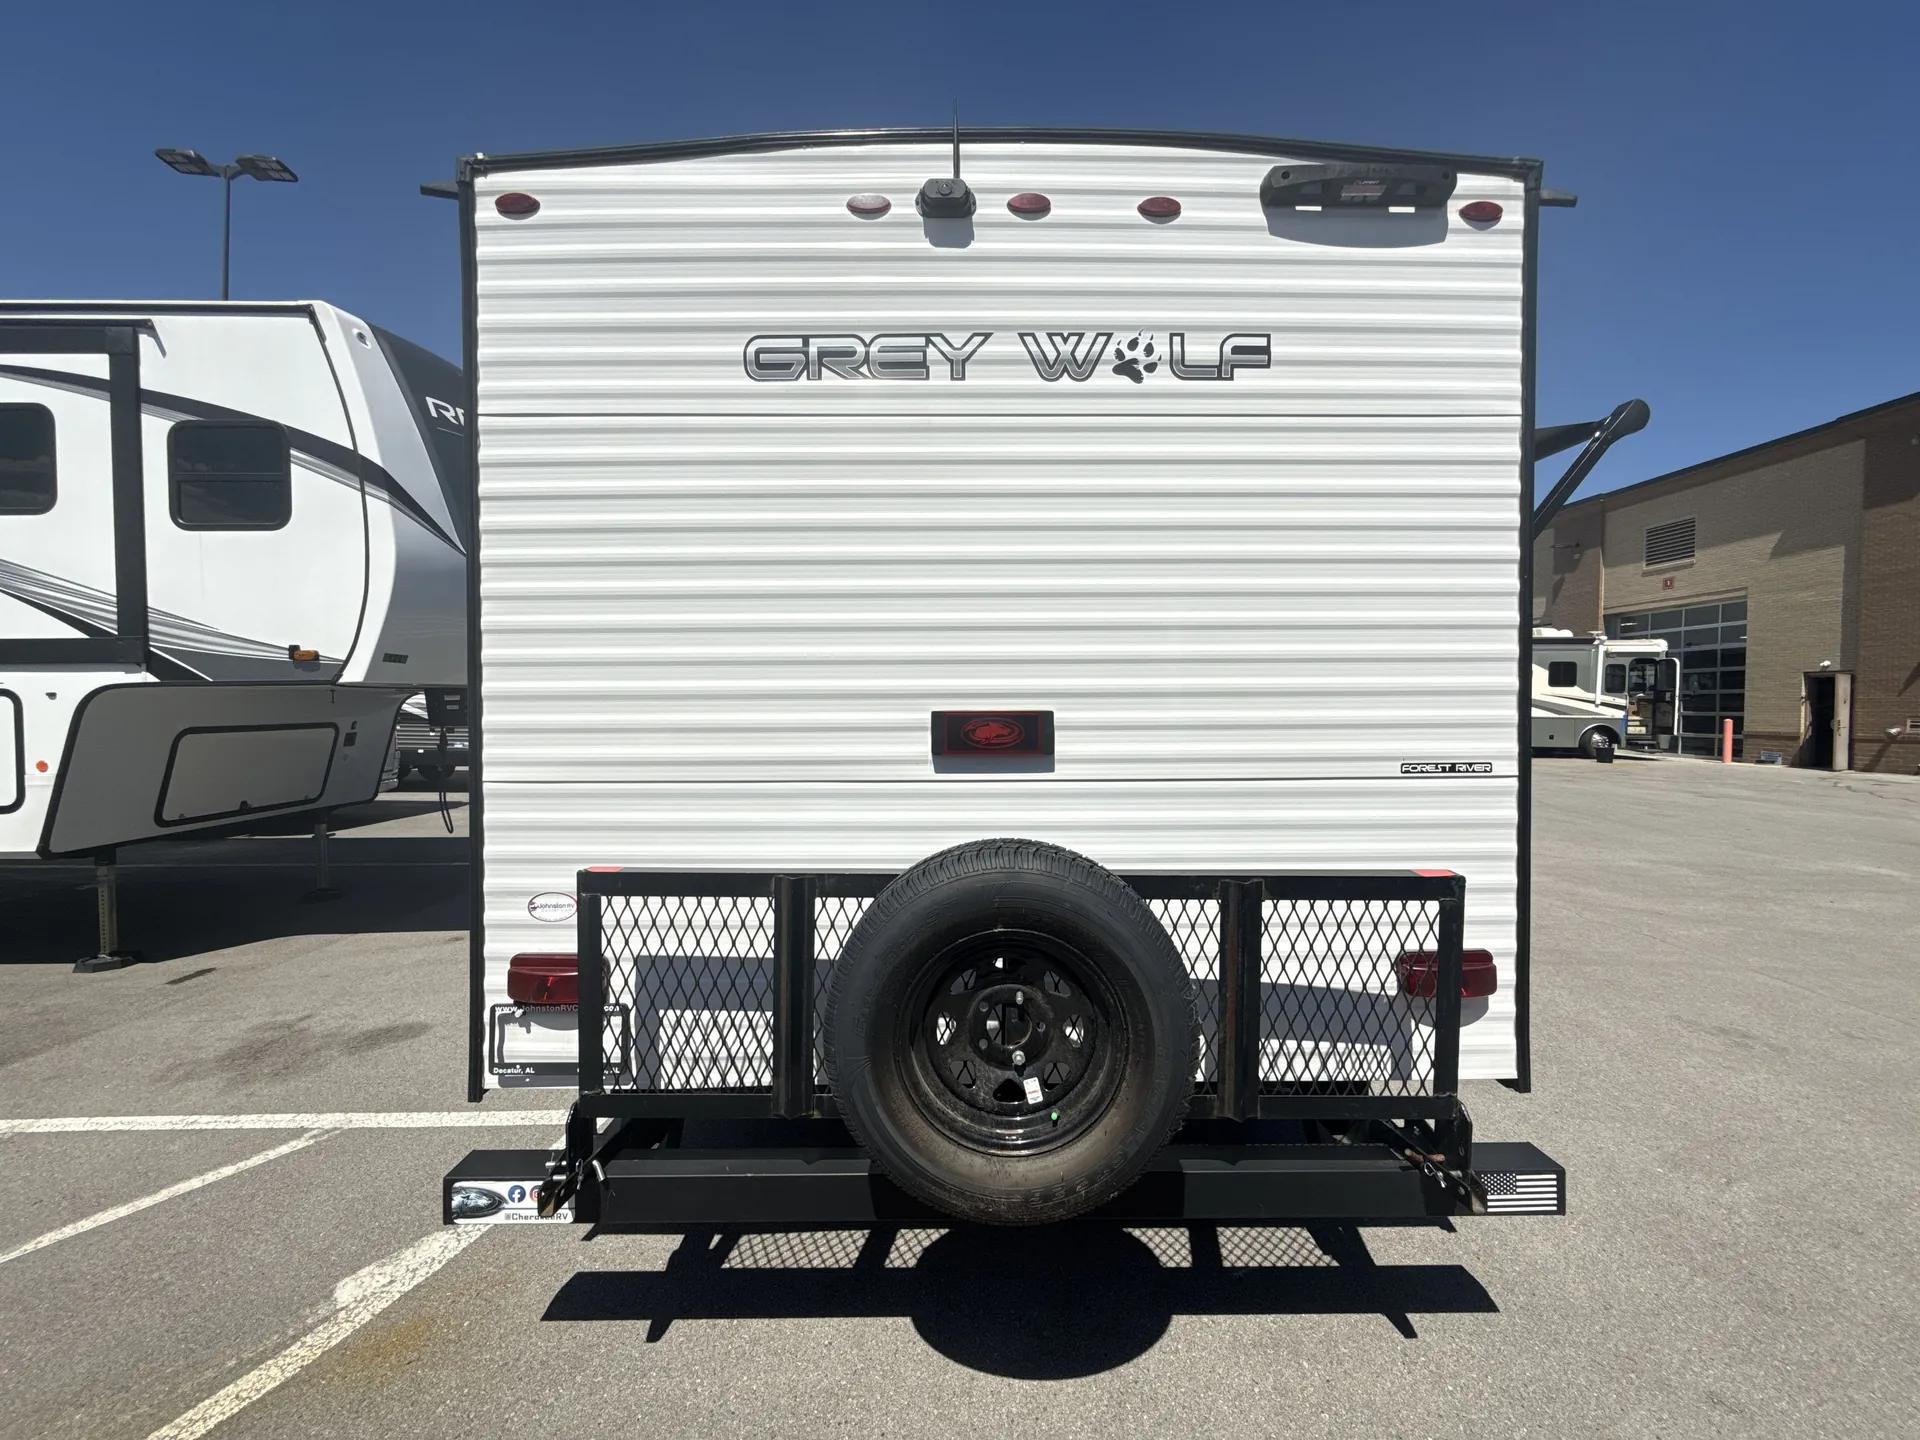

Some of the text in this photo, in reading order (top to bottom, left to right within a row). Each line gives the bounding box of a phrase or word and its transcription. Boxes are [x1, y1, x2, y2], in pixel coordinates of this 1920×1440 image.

[742, 329, 1273, 384] GREY WLF
[1402, 763, 1492, 773] FOREST RIVER
[493, 1066, 524, 1075] Decatur,
